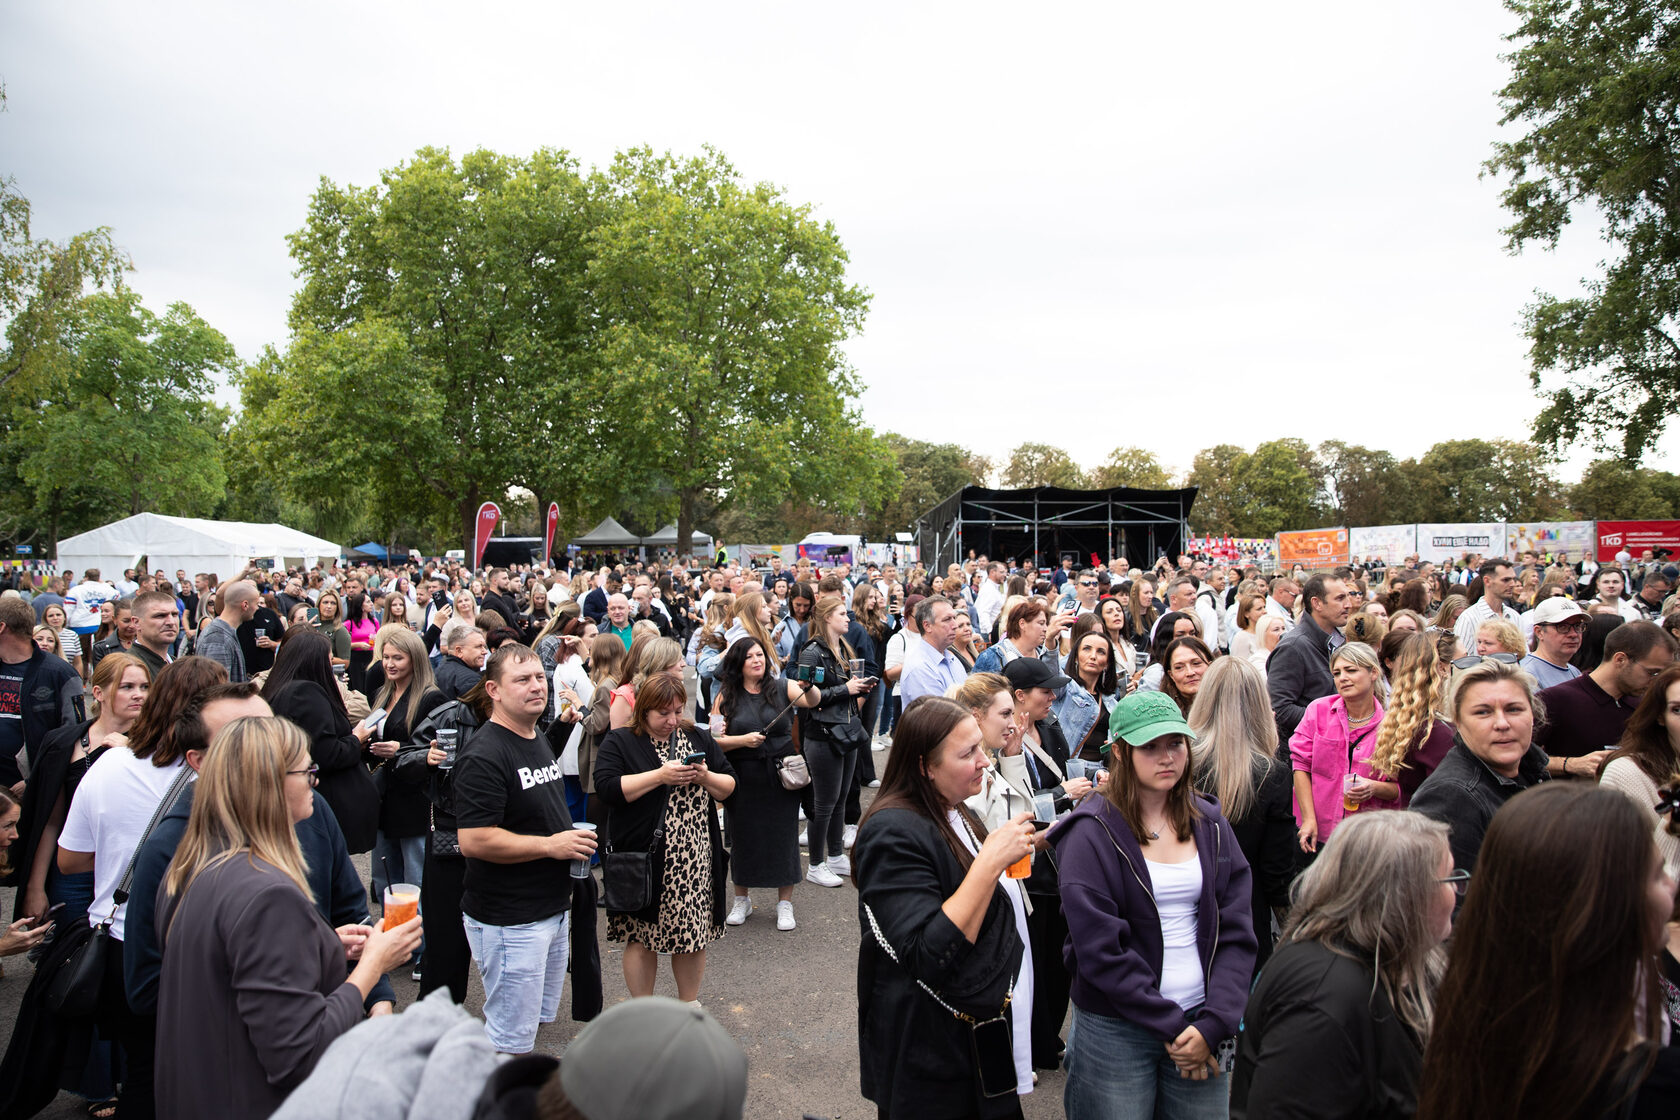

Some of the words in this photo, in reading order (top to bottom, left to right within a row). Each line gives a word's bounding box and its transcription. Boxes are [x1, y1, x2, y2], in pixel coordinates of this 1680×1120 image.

[482, 509, 496, 519] TKD
[1468, 537, 1489, 546] НАДО
[1600, 532, 1622, 545] TKD
